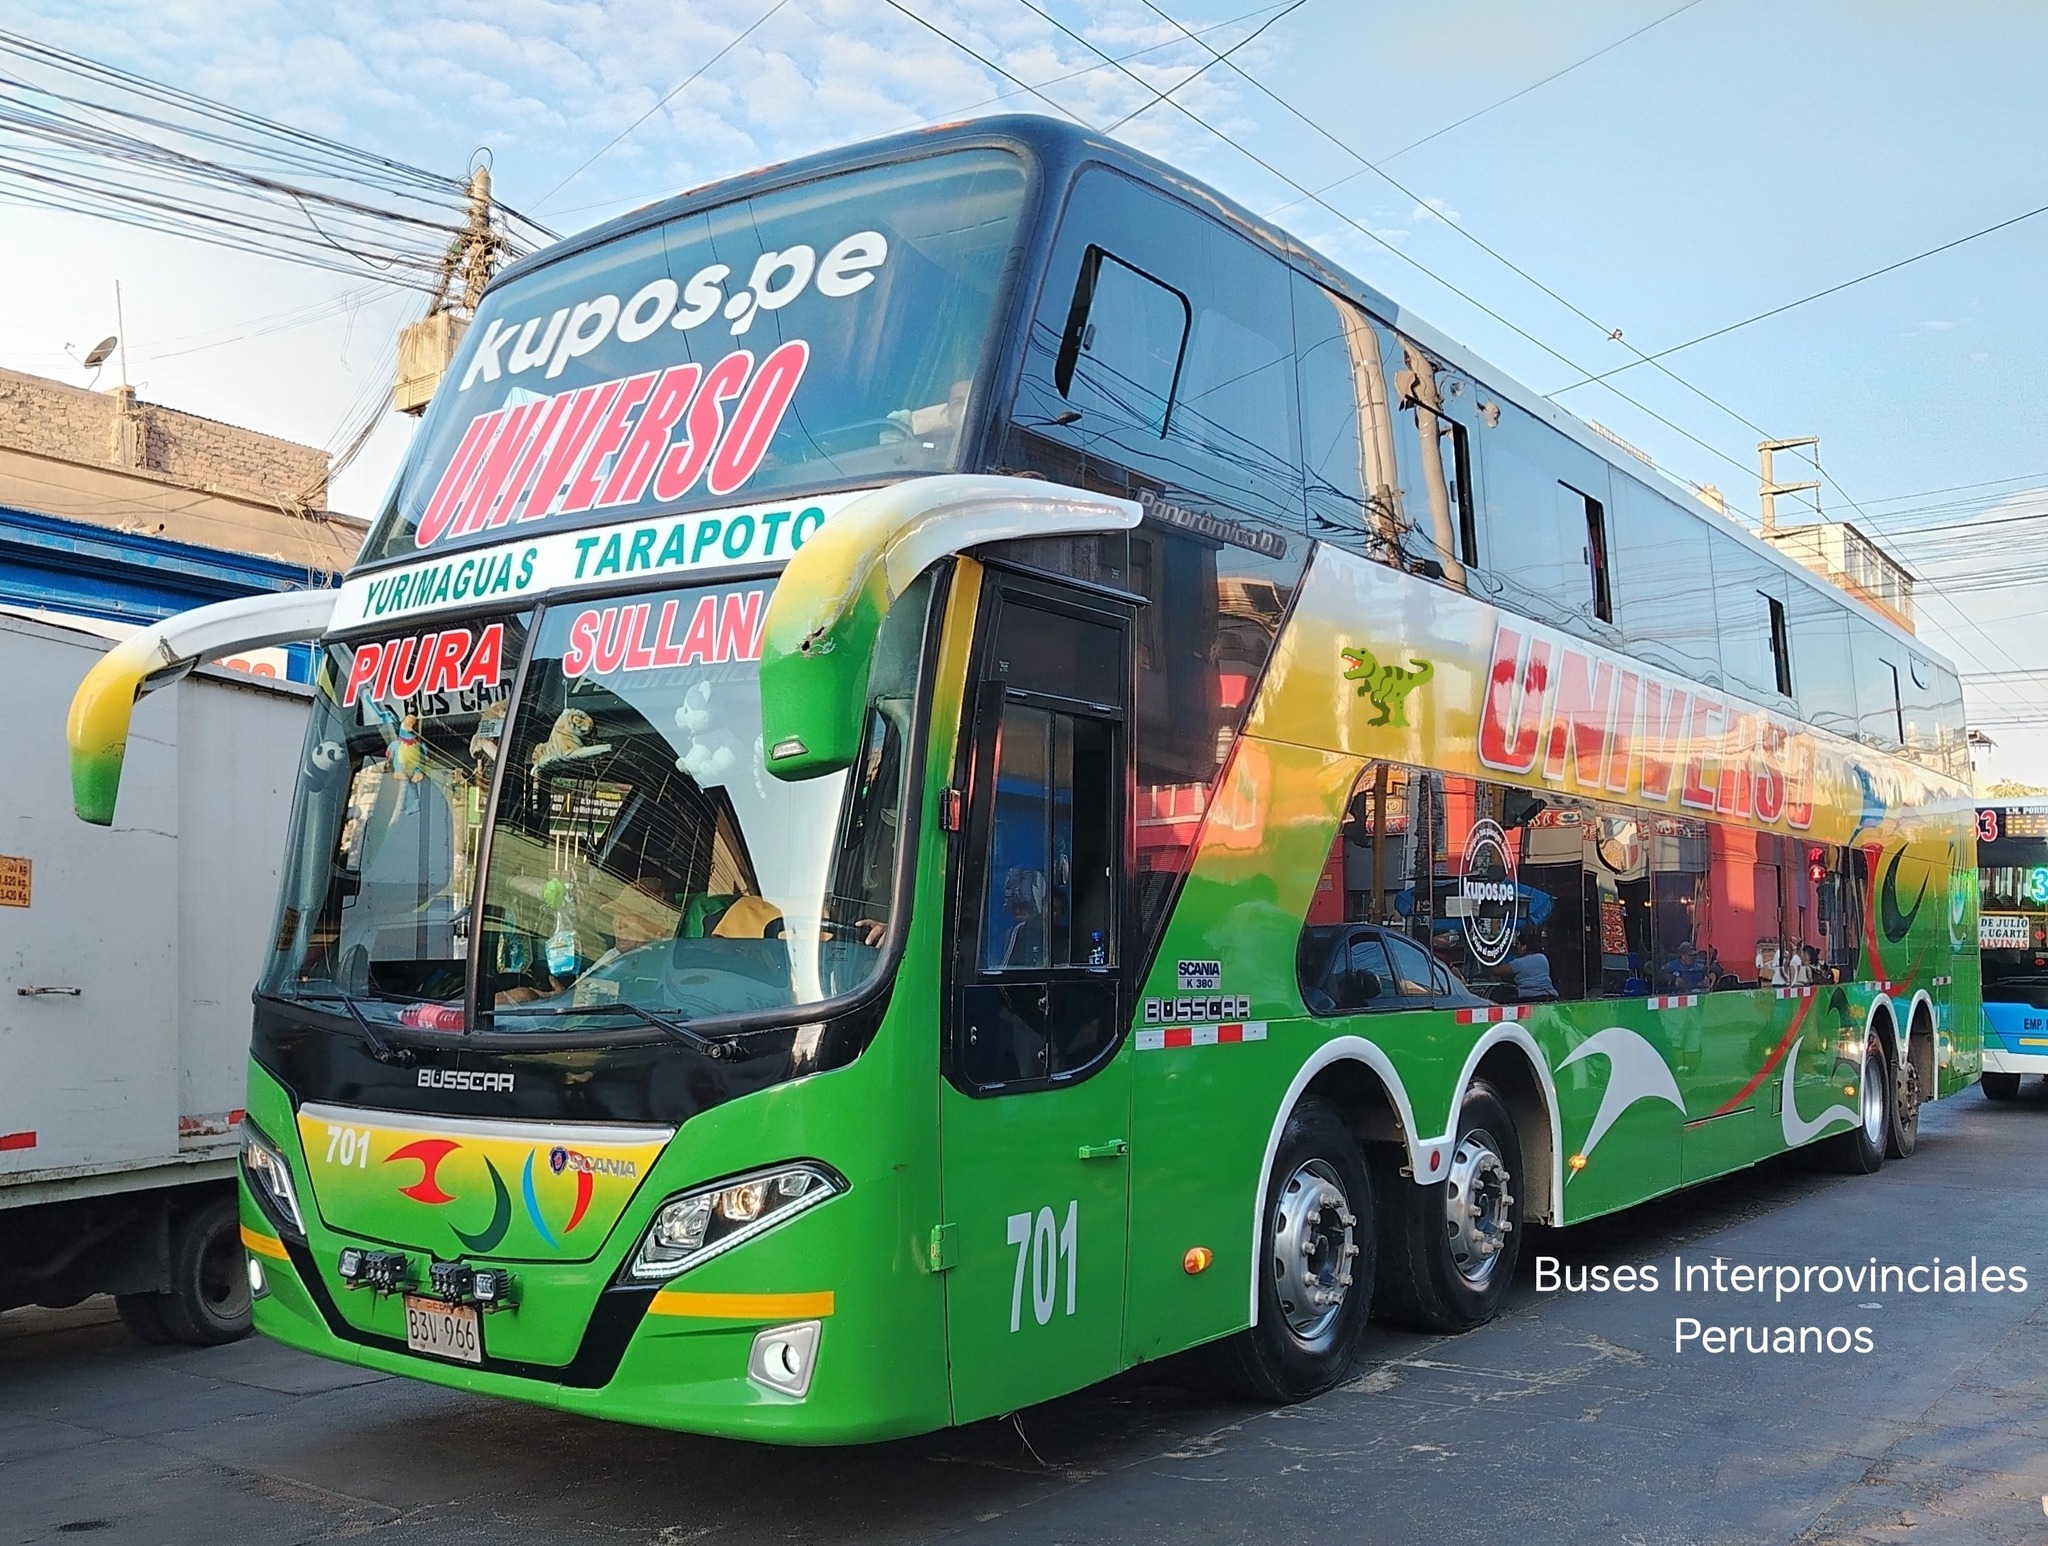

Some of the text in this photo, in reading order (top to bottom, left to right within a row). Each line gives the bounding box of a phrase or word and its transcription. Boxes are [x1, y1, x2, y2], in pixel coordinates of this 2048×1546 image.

[458, 230, 888, 392] kupos.pe
[415, 339, 810, 549] UNIVERSO
[361, 507, 826, 619] YURIMAGUAS TARAPOTO
[342, 590, 773, 709] PIURA SULLAN
[1476, 622, 1816, 830] UNIVERSO
[1463, 876, 1514, 906] kupos.pe
[1981, 918, 2028, 928] DE JULIO
[1989, 929, 2028, 938] UGARTE
[1178, 961, 1220, 976] SCANIA
[1186, 978, 1213, 989] K 380
[1143, 994, 1251, 1024] BUSSCAR
[2023, 1017, 2043, 1030] EMP.
[417, 1067, 515, 1093] BUSSCAR
[325, 1125, 637, 1179] 701 SCANIA
[1006, 1199, 1079, 1334] 701
[408, 1308, 476, 1352] B3V-966
